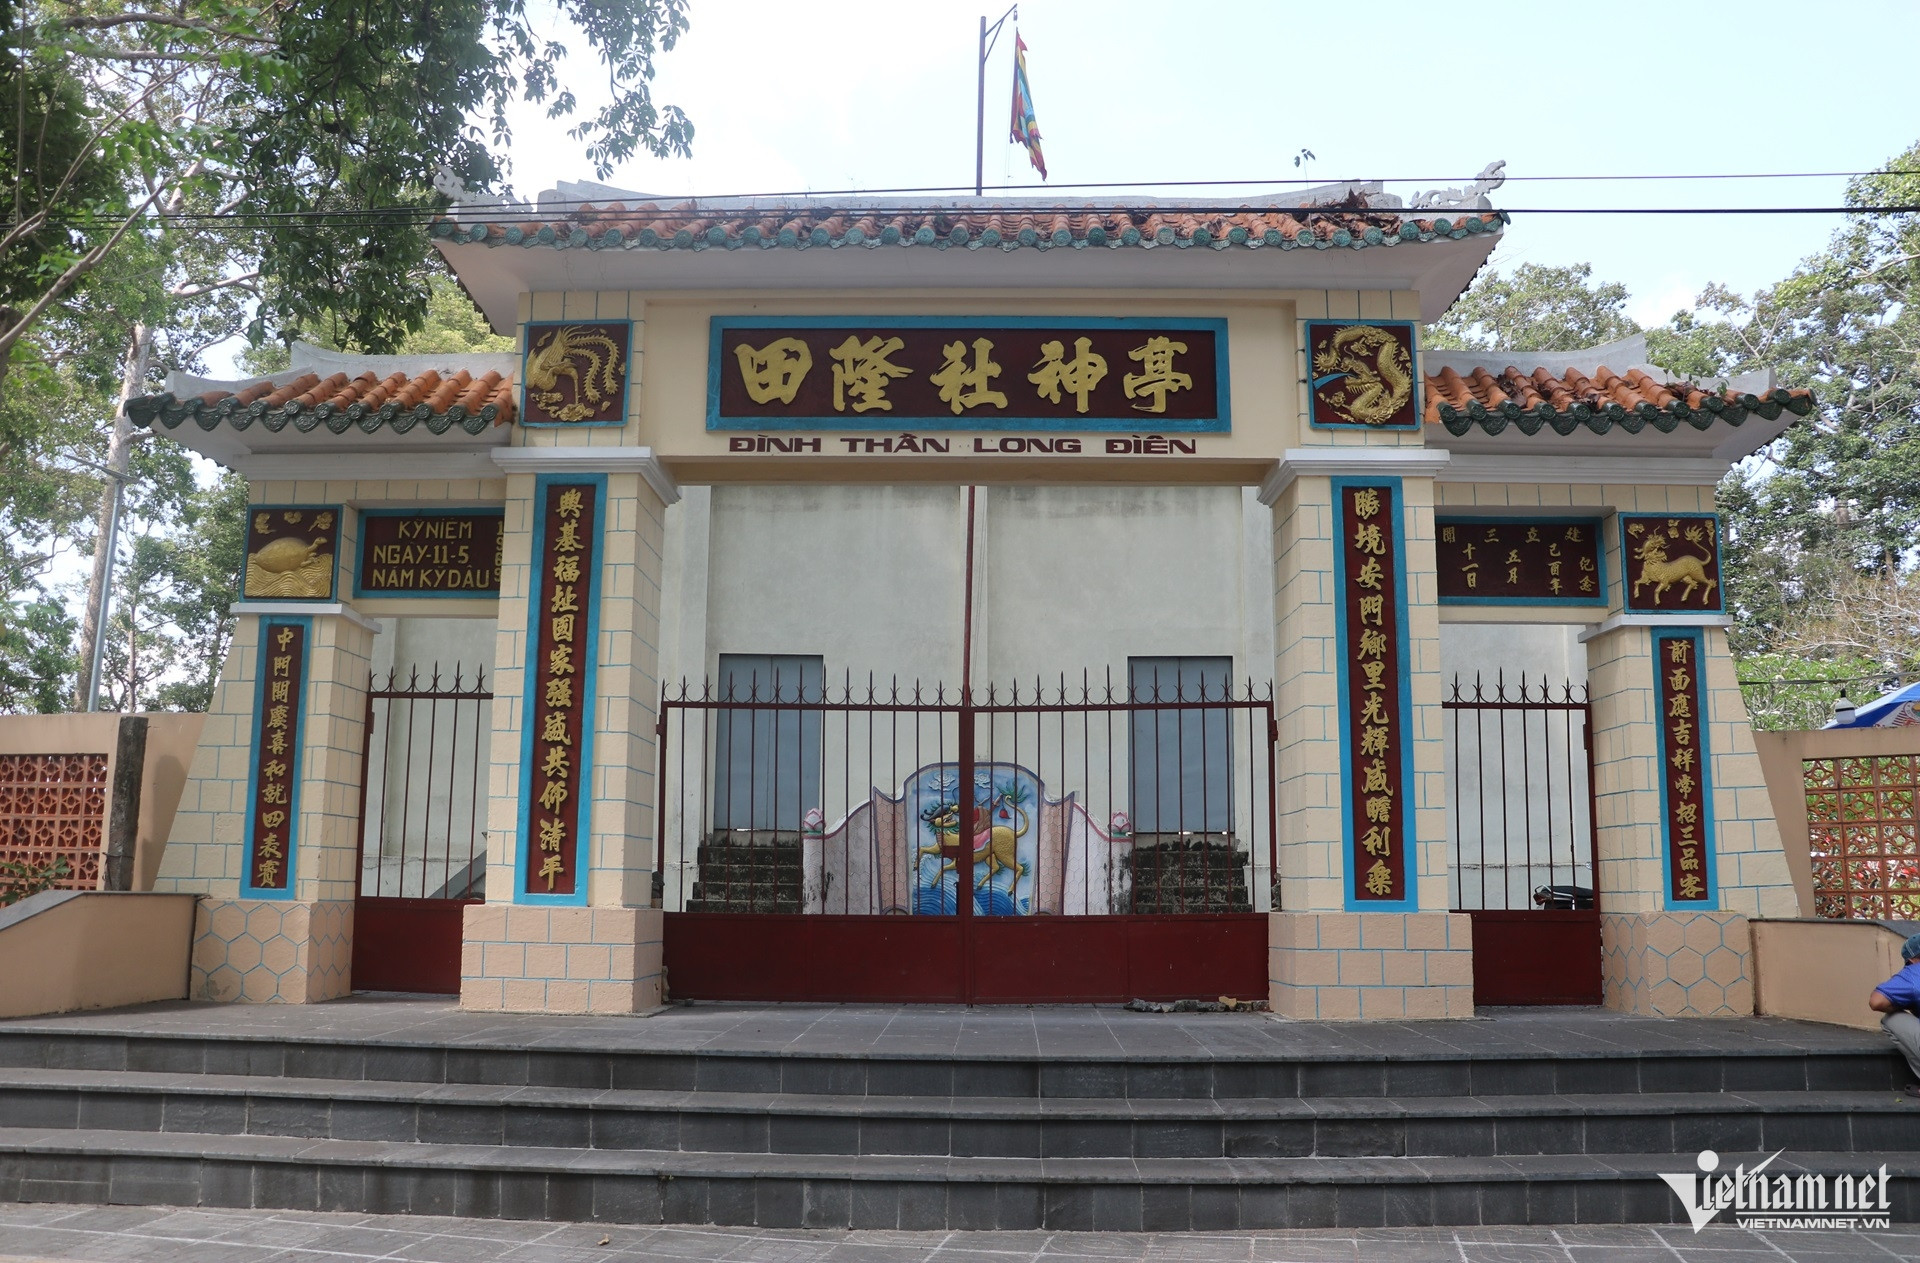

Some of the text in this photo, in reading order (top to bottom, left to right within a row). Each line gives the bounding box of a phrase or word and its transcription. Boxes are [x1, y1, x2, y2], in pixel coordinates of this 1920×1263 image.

[729, 433, 822, 453] ĐÌNH
[840, 432, 950, 453] THẦN
[973, 437, 1082, 453] LONG
